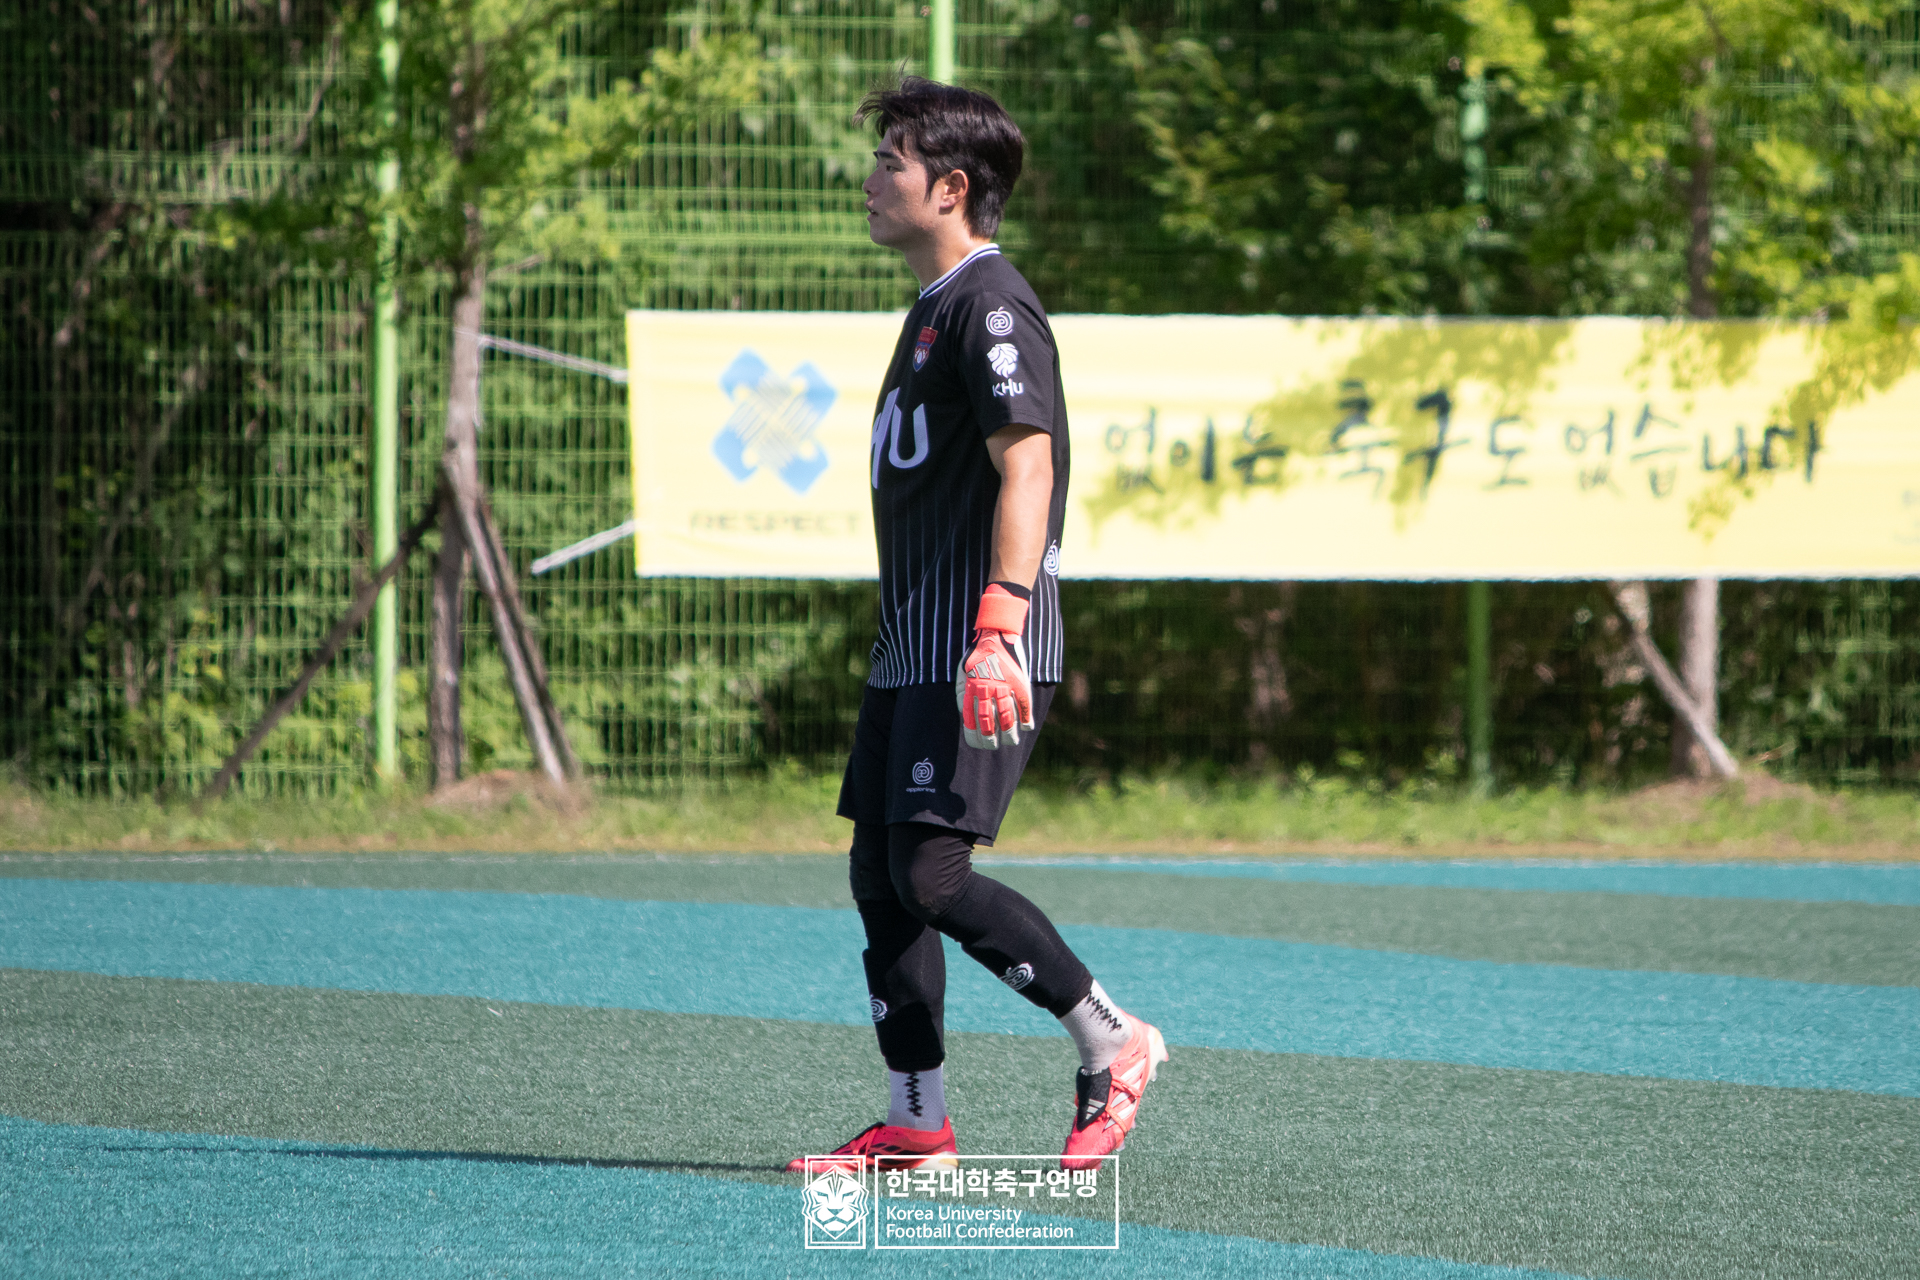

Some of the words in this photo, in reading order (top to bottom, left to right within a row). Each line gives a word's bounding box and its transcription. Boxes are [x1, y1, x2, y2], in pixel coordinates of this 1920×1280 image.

[992, 378, 1024, 397] KHU
[1105, 407, 1288, 493] 없이는
[1322, 378, 1528, 500] 축구도
[1564, 403, 1822, 498] 없습니다
[690, 511, 860, 535] RESPECT
